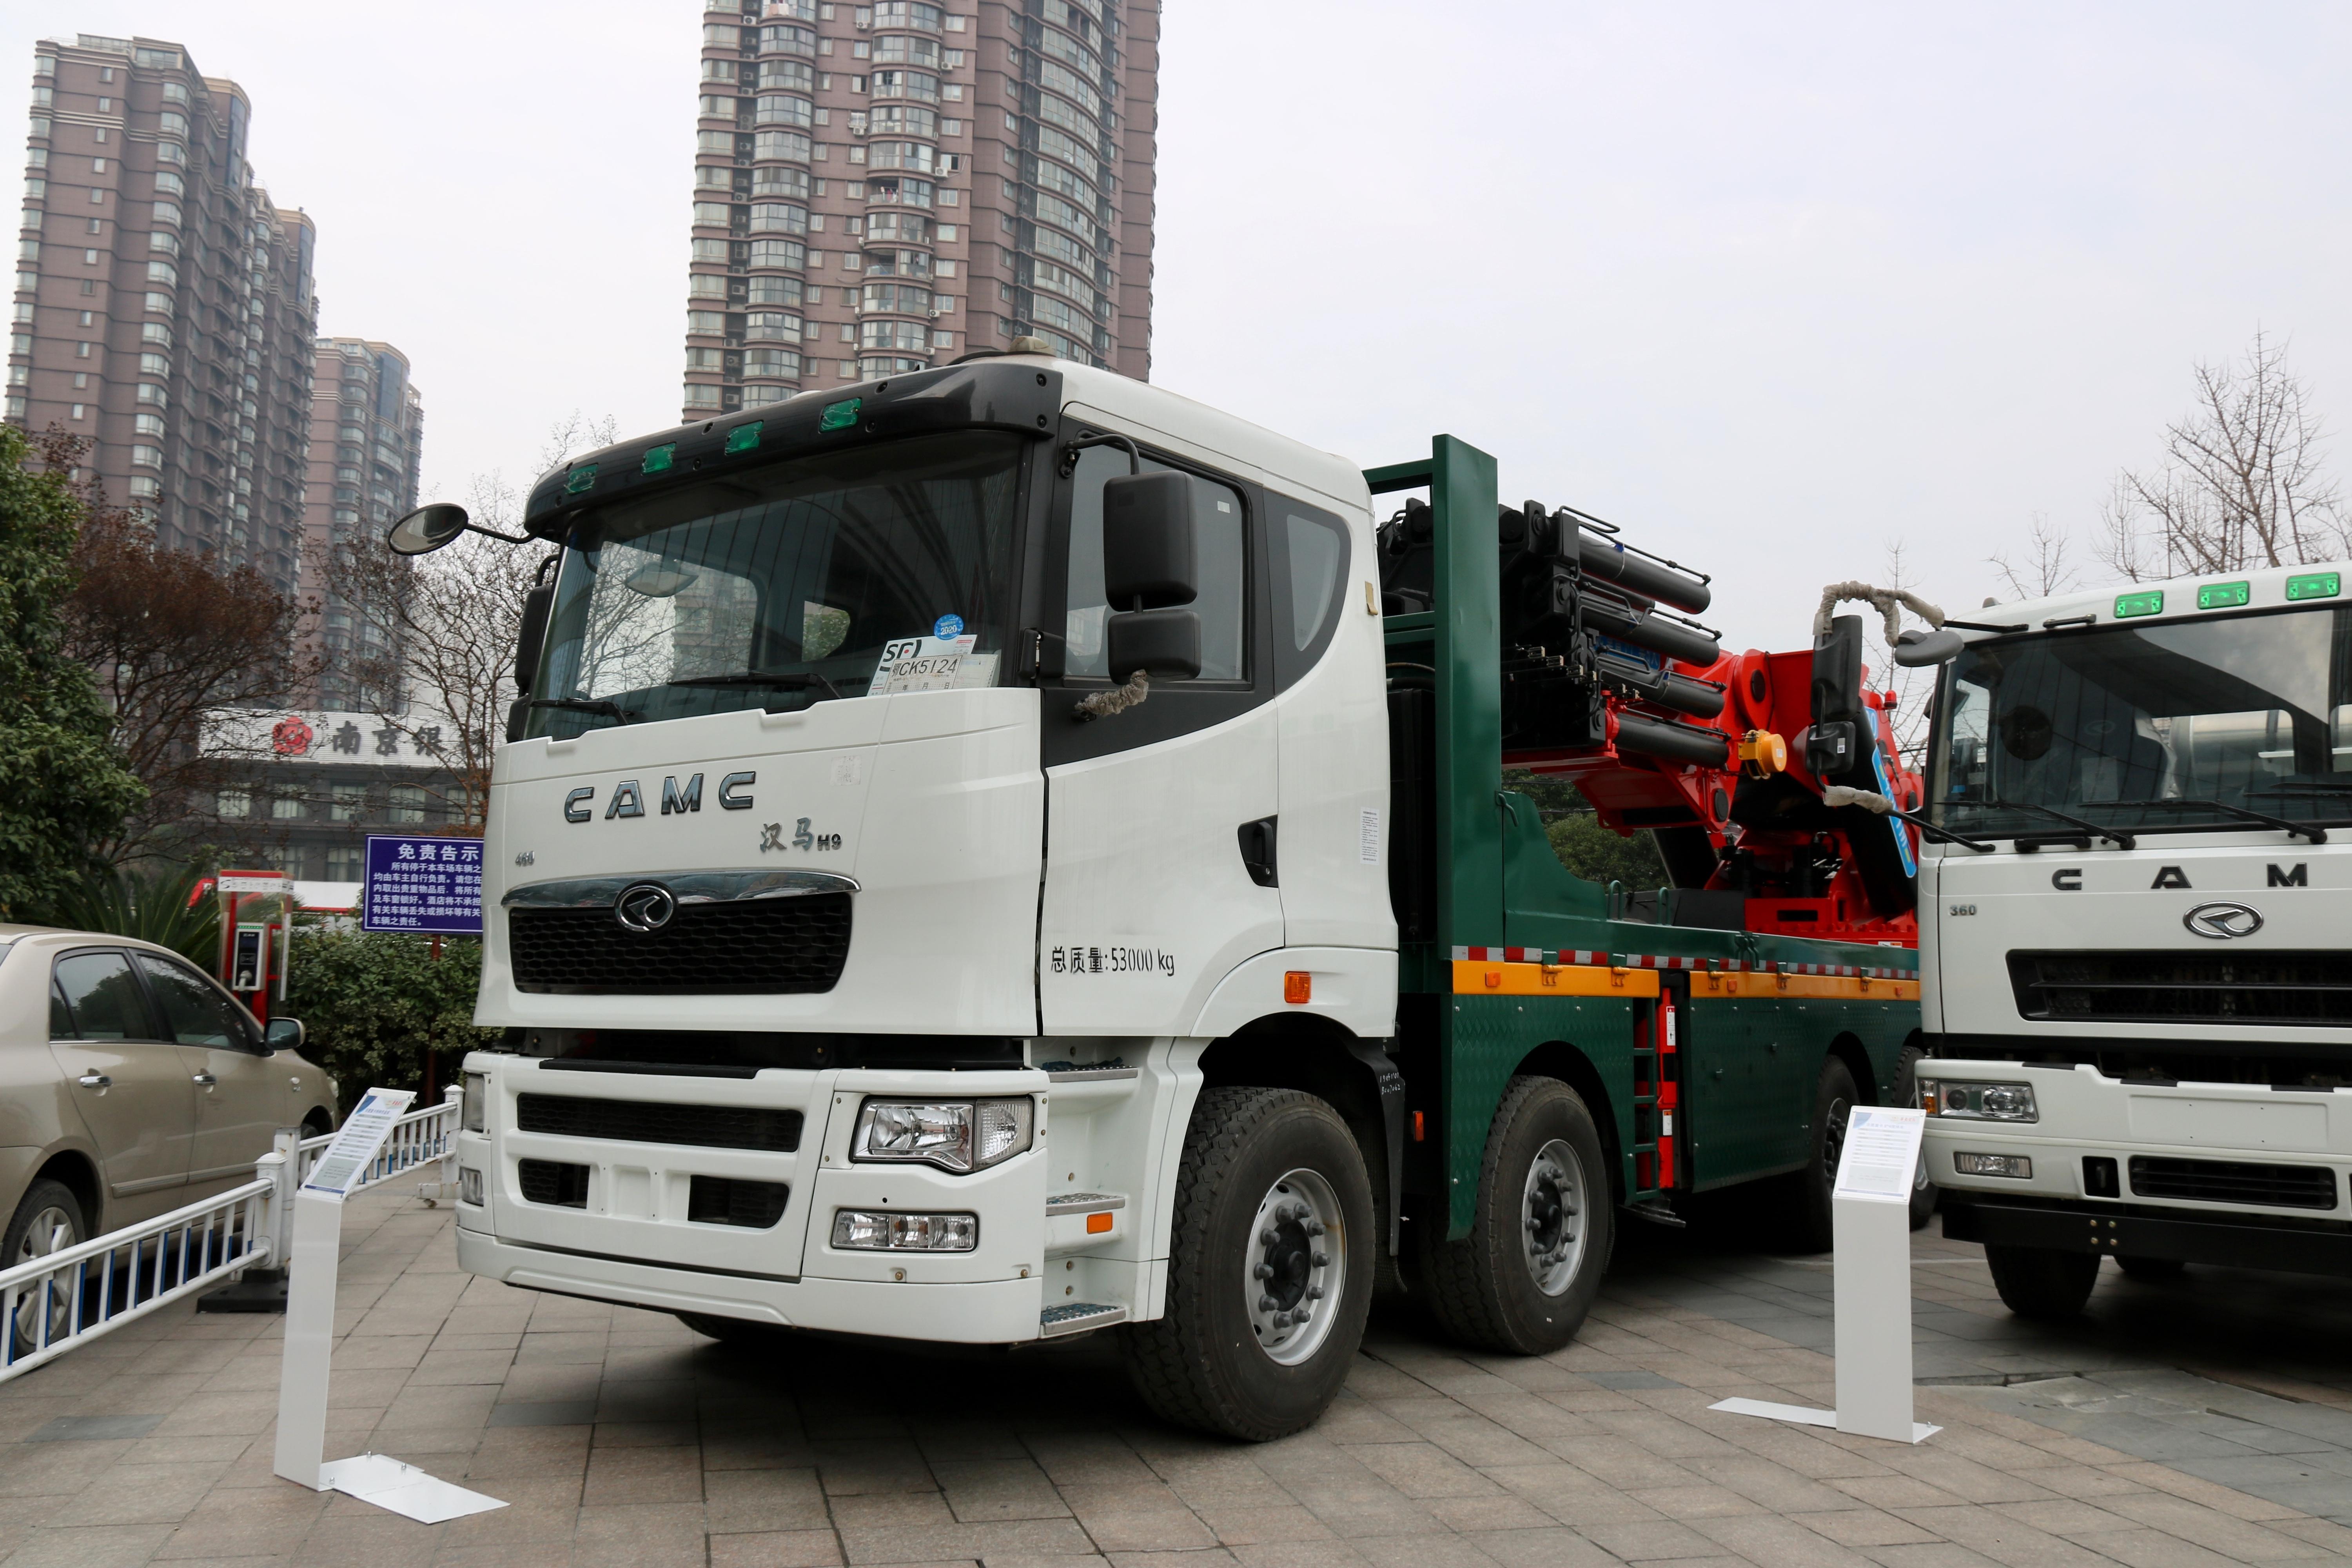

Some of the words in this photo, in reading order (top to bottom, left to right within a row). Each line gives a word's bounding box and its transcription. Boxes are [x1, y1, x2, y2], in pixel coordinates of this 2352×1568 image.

[941, 625, 957, 635] 2020
[564, 771, 756, 823] CAMC
[398, 843, 479, 861] 免责告示
[391, 862, 482, 873] 所有停于本车场车辆之
[1949, 904, 1977, 916] 360
[372, 916, 422, 926] 车辆之责任。
[1158, 948, 1174, 976] kg
